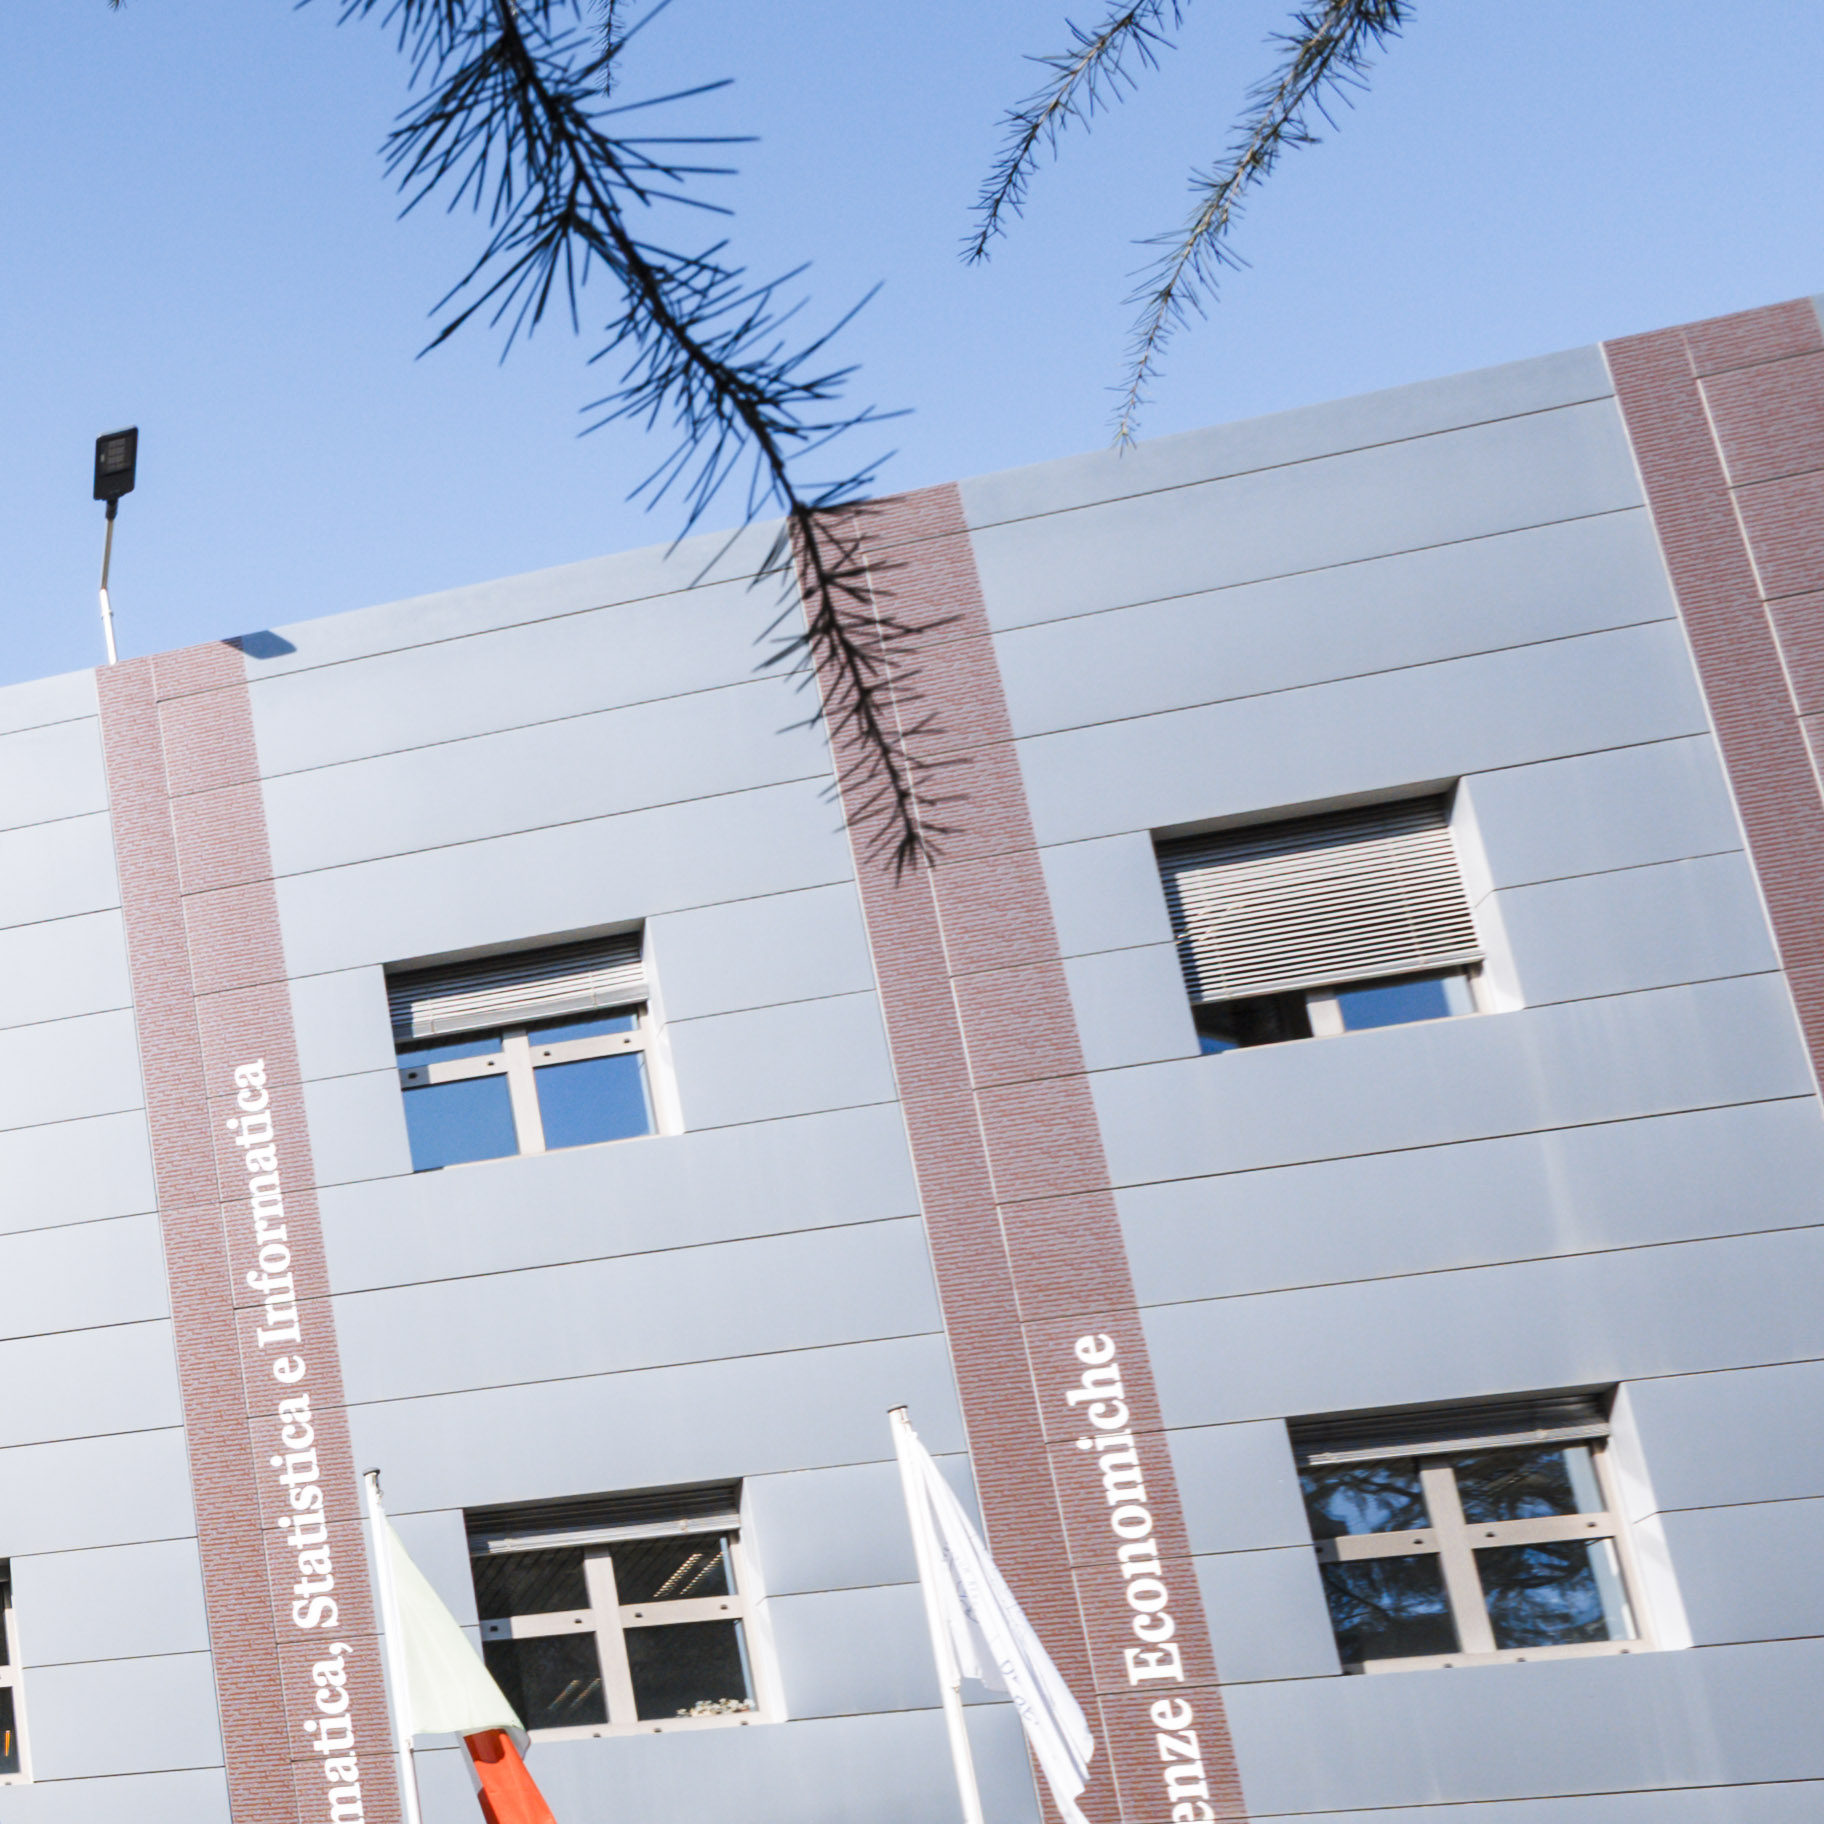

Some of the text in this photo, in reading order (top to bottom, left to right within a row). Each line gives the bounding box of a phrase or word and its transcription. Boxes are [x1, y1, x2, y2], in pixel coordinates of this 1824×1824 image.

[226, 1058, 302, 1348] Informatica
[272, 1355, 306, 1384] e
[269, 1392, 340, 1629] Statistica
[1065, 1333, 1185, 1686] Economiche
